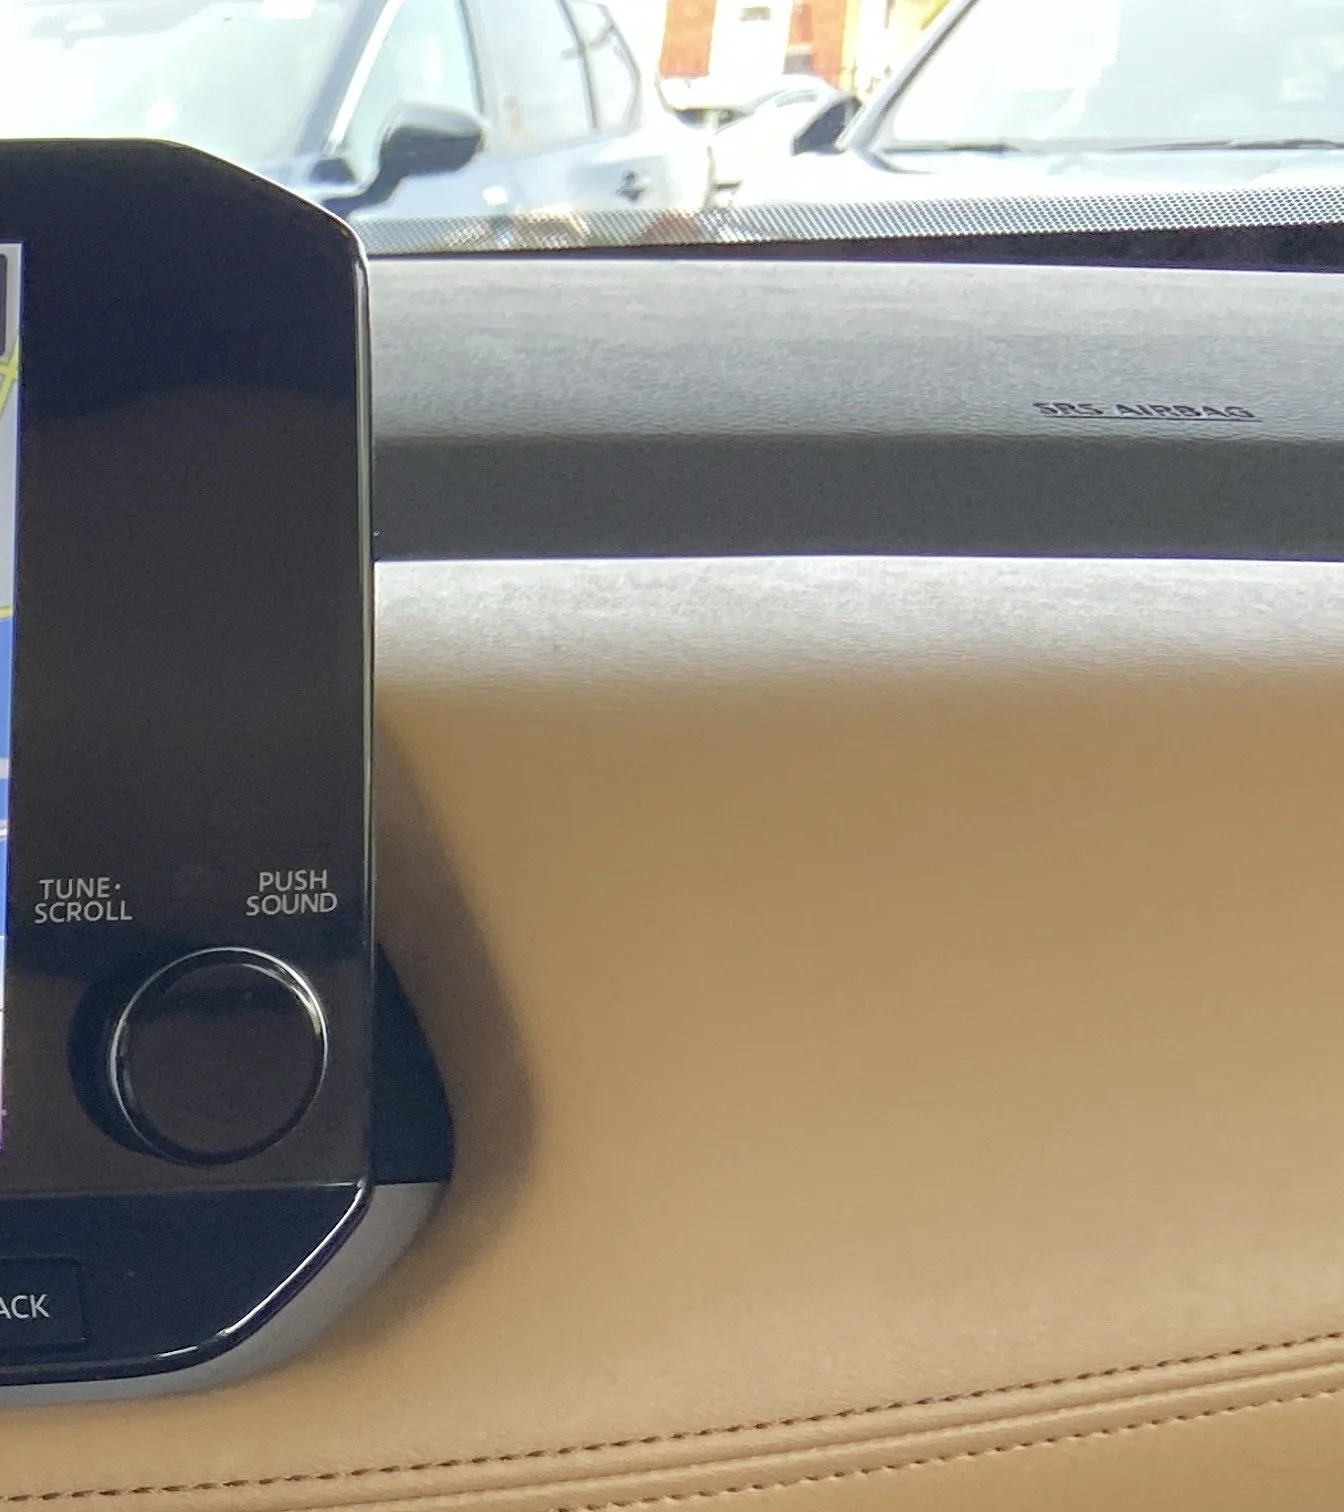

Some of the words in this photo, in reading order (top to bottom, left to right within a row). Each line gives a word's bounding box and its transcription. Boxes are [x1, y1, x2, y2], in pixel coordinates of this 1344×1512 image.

[1032, 402, 1104, 415] SRS
[1115, 403, 1256, 418] AIRBAG
[259, 869, 328, 893] PUSH
[34, 900, 133, 924] SCROLL
[246, 892, 338, 917] SOUND
